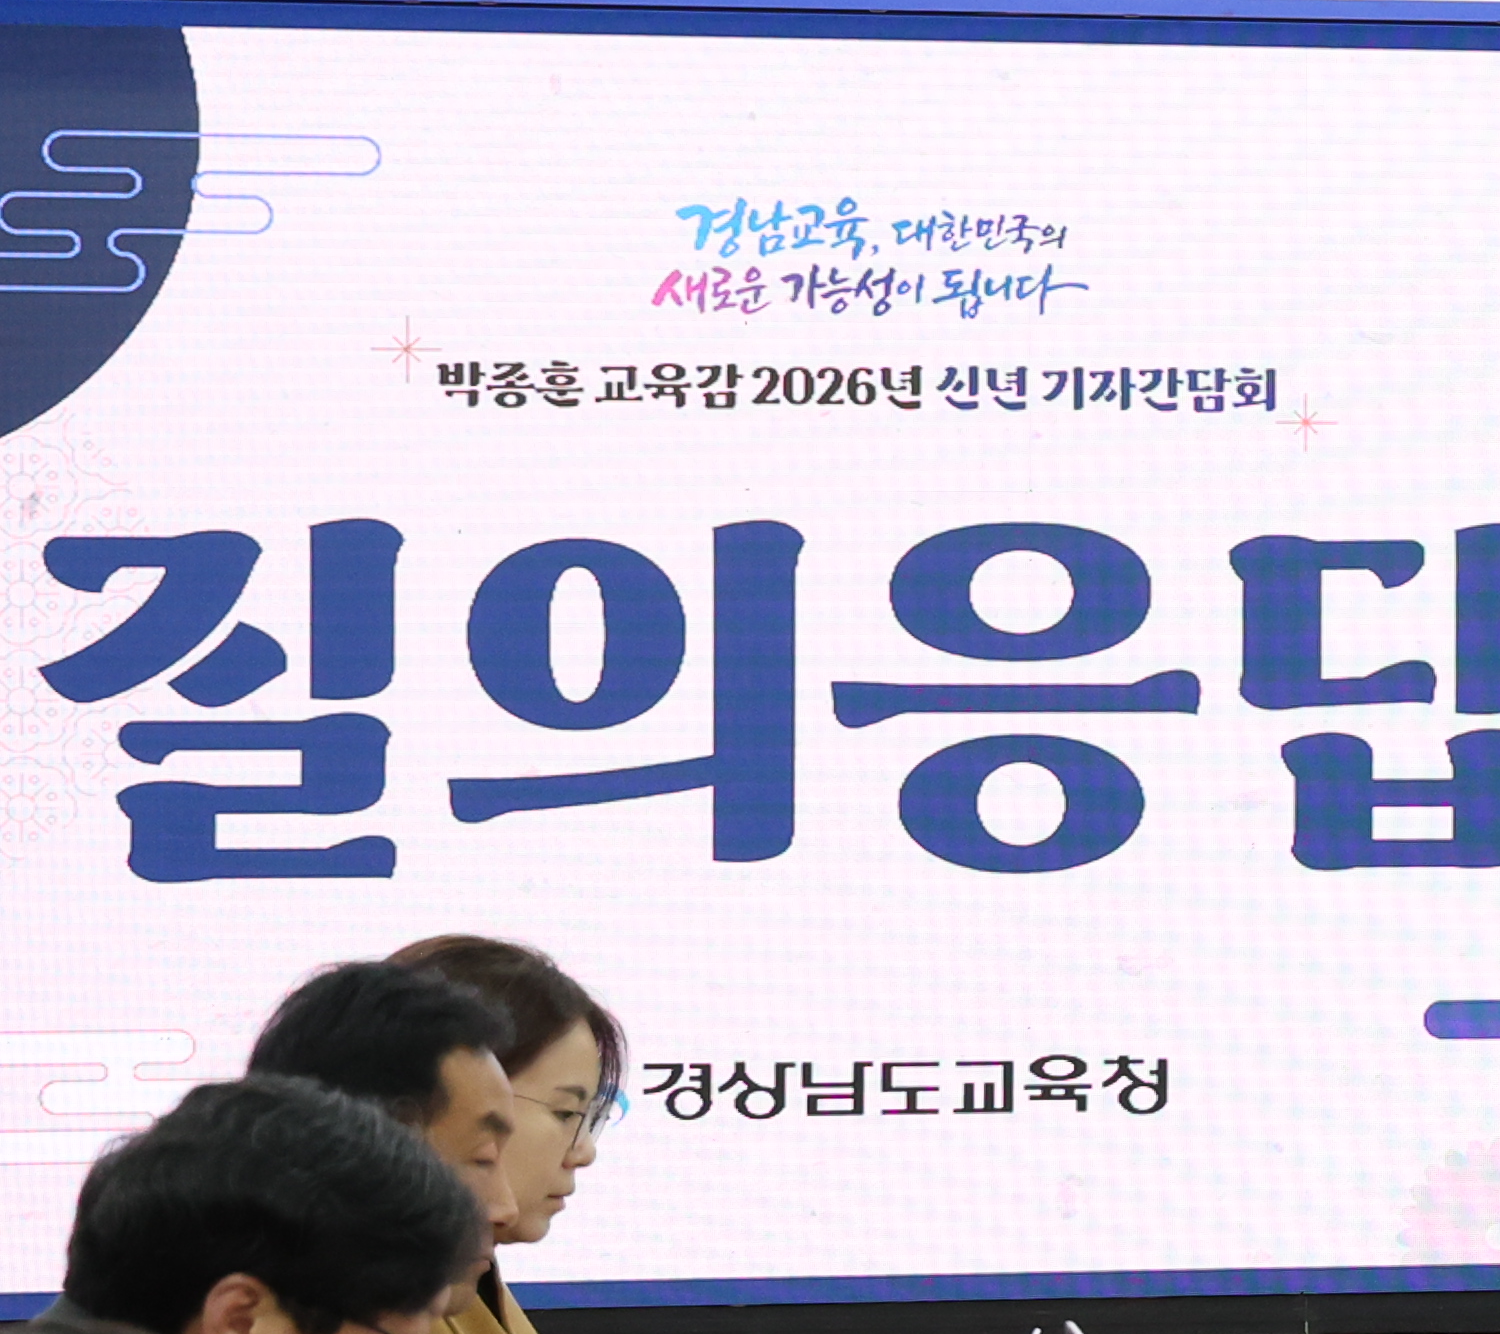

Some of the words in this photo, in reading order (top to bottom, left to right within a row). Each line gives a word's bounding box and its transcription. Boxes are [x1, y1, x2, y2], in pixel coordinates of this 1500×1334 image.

[676, 197, 880, 260] 경남교육,
[892, 210, 1067, 254] 대한민국의
[652, 267, 769, 314] 새로운
[781, 264, 925, 317] 가능성이
[932, 264, 1089, 319] 됩니다
[437, 360, 584, 408] 박종훈
[595, 363, 744, 409] 교육감
[752, 365, 922, 410] 2026년
[936, 366, 1027, 411] 신년
[1042, 367, 1276, 413] 기자간담회
[643, 1054, 1168, 1121] 경상남도교육청
